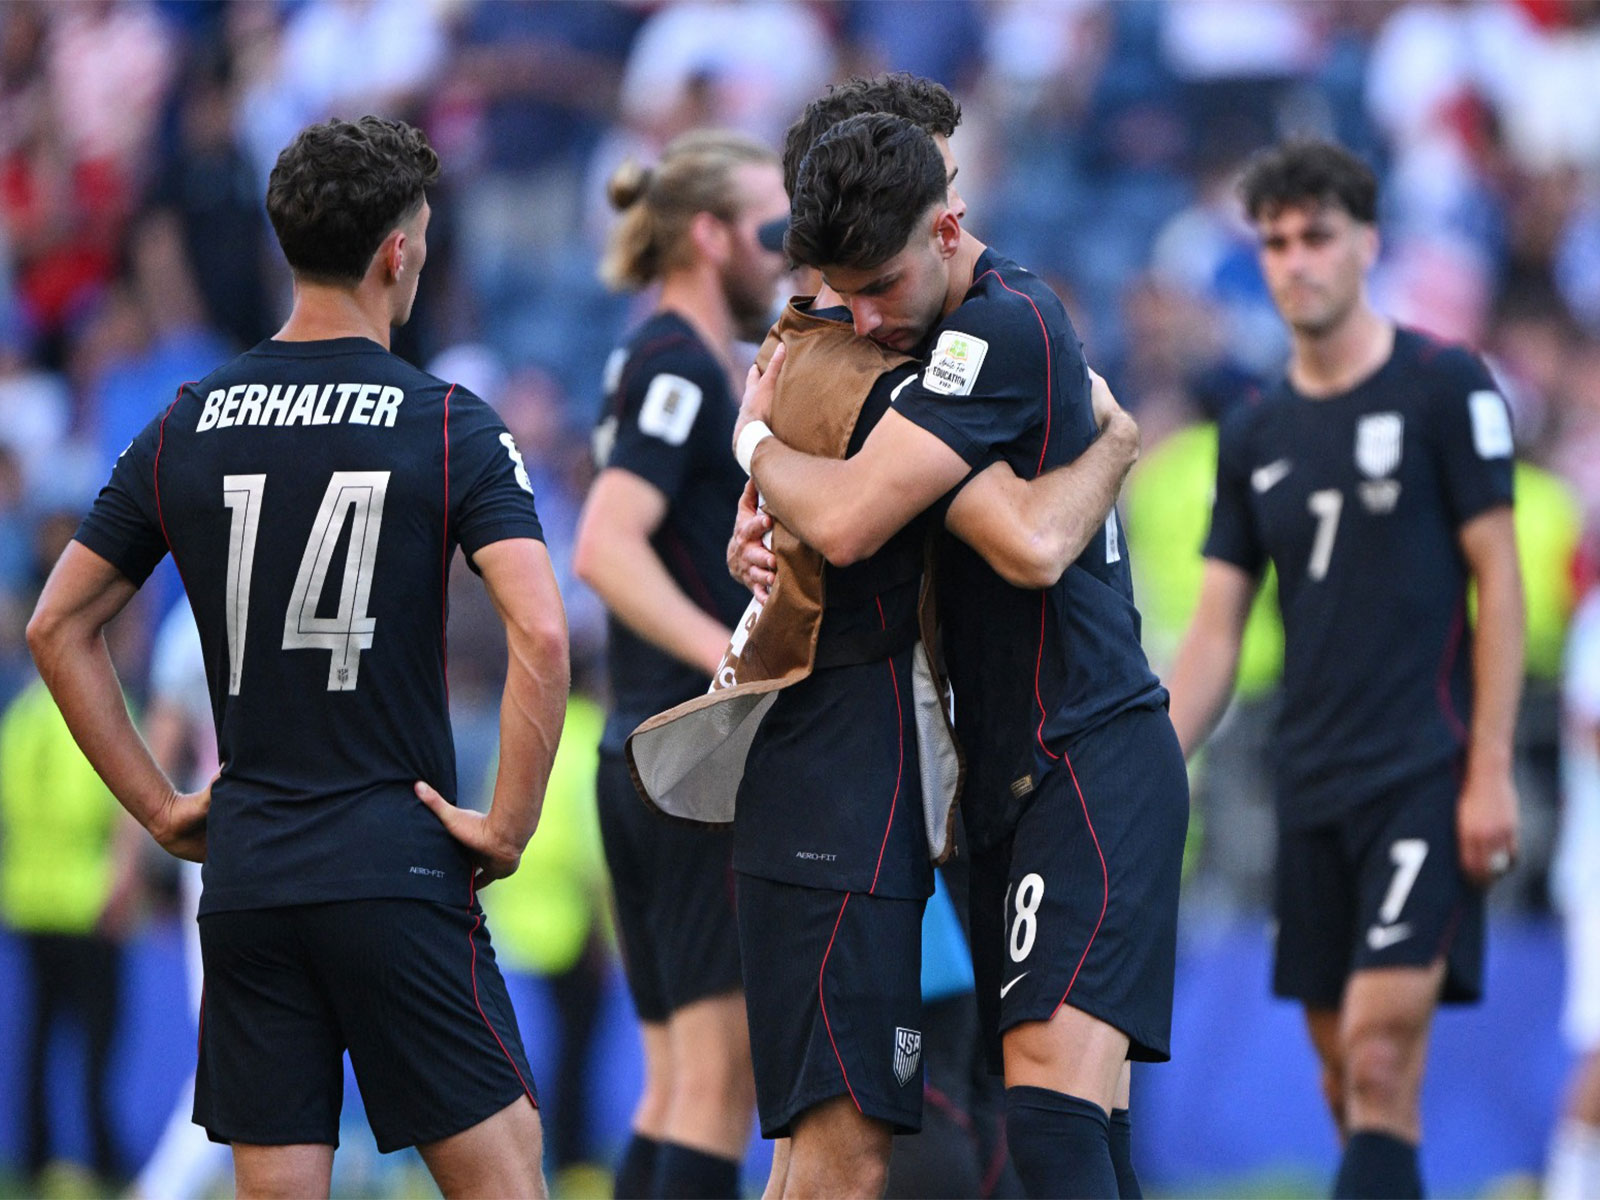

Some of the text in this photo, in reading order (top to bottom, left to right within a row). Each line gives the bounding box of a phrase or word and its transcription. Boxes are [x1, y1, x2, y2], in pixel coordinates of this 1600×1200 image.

[196, 383, 404, 433] BERHALTER
[932, 366, 967, 387] EDUCATION
[1308, 489, 1343, 581] 7
[223, 470, 391, 696] 14
[795, 851, 837, 861] AERO-FIT
[1379, 838, 1429, 924] 7
[1004, 872, 1045, 963] 8
[899, 1031, 920, 1054] USA
